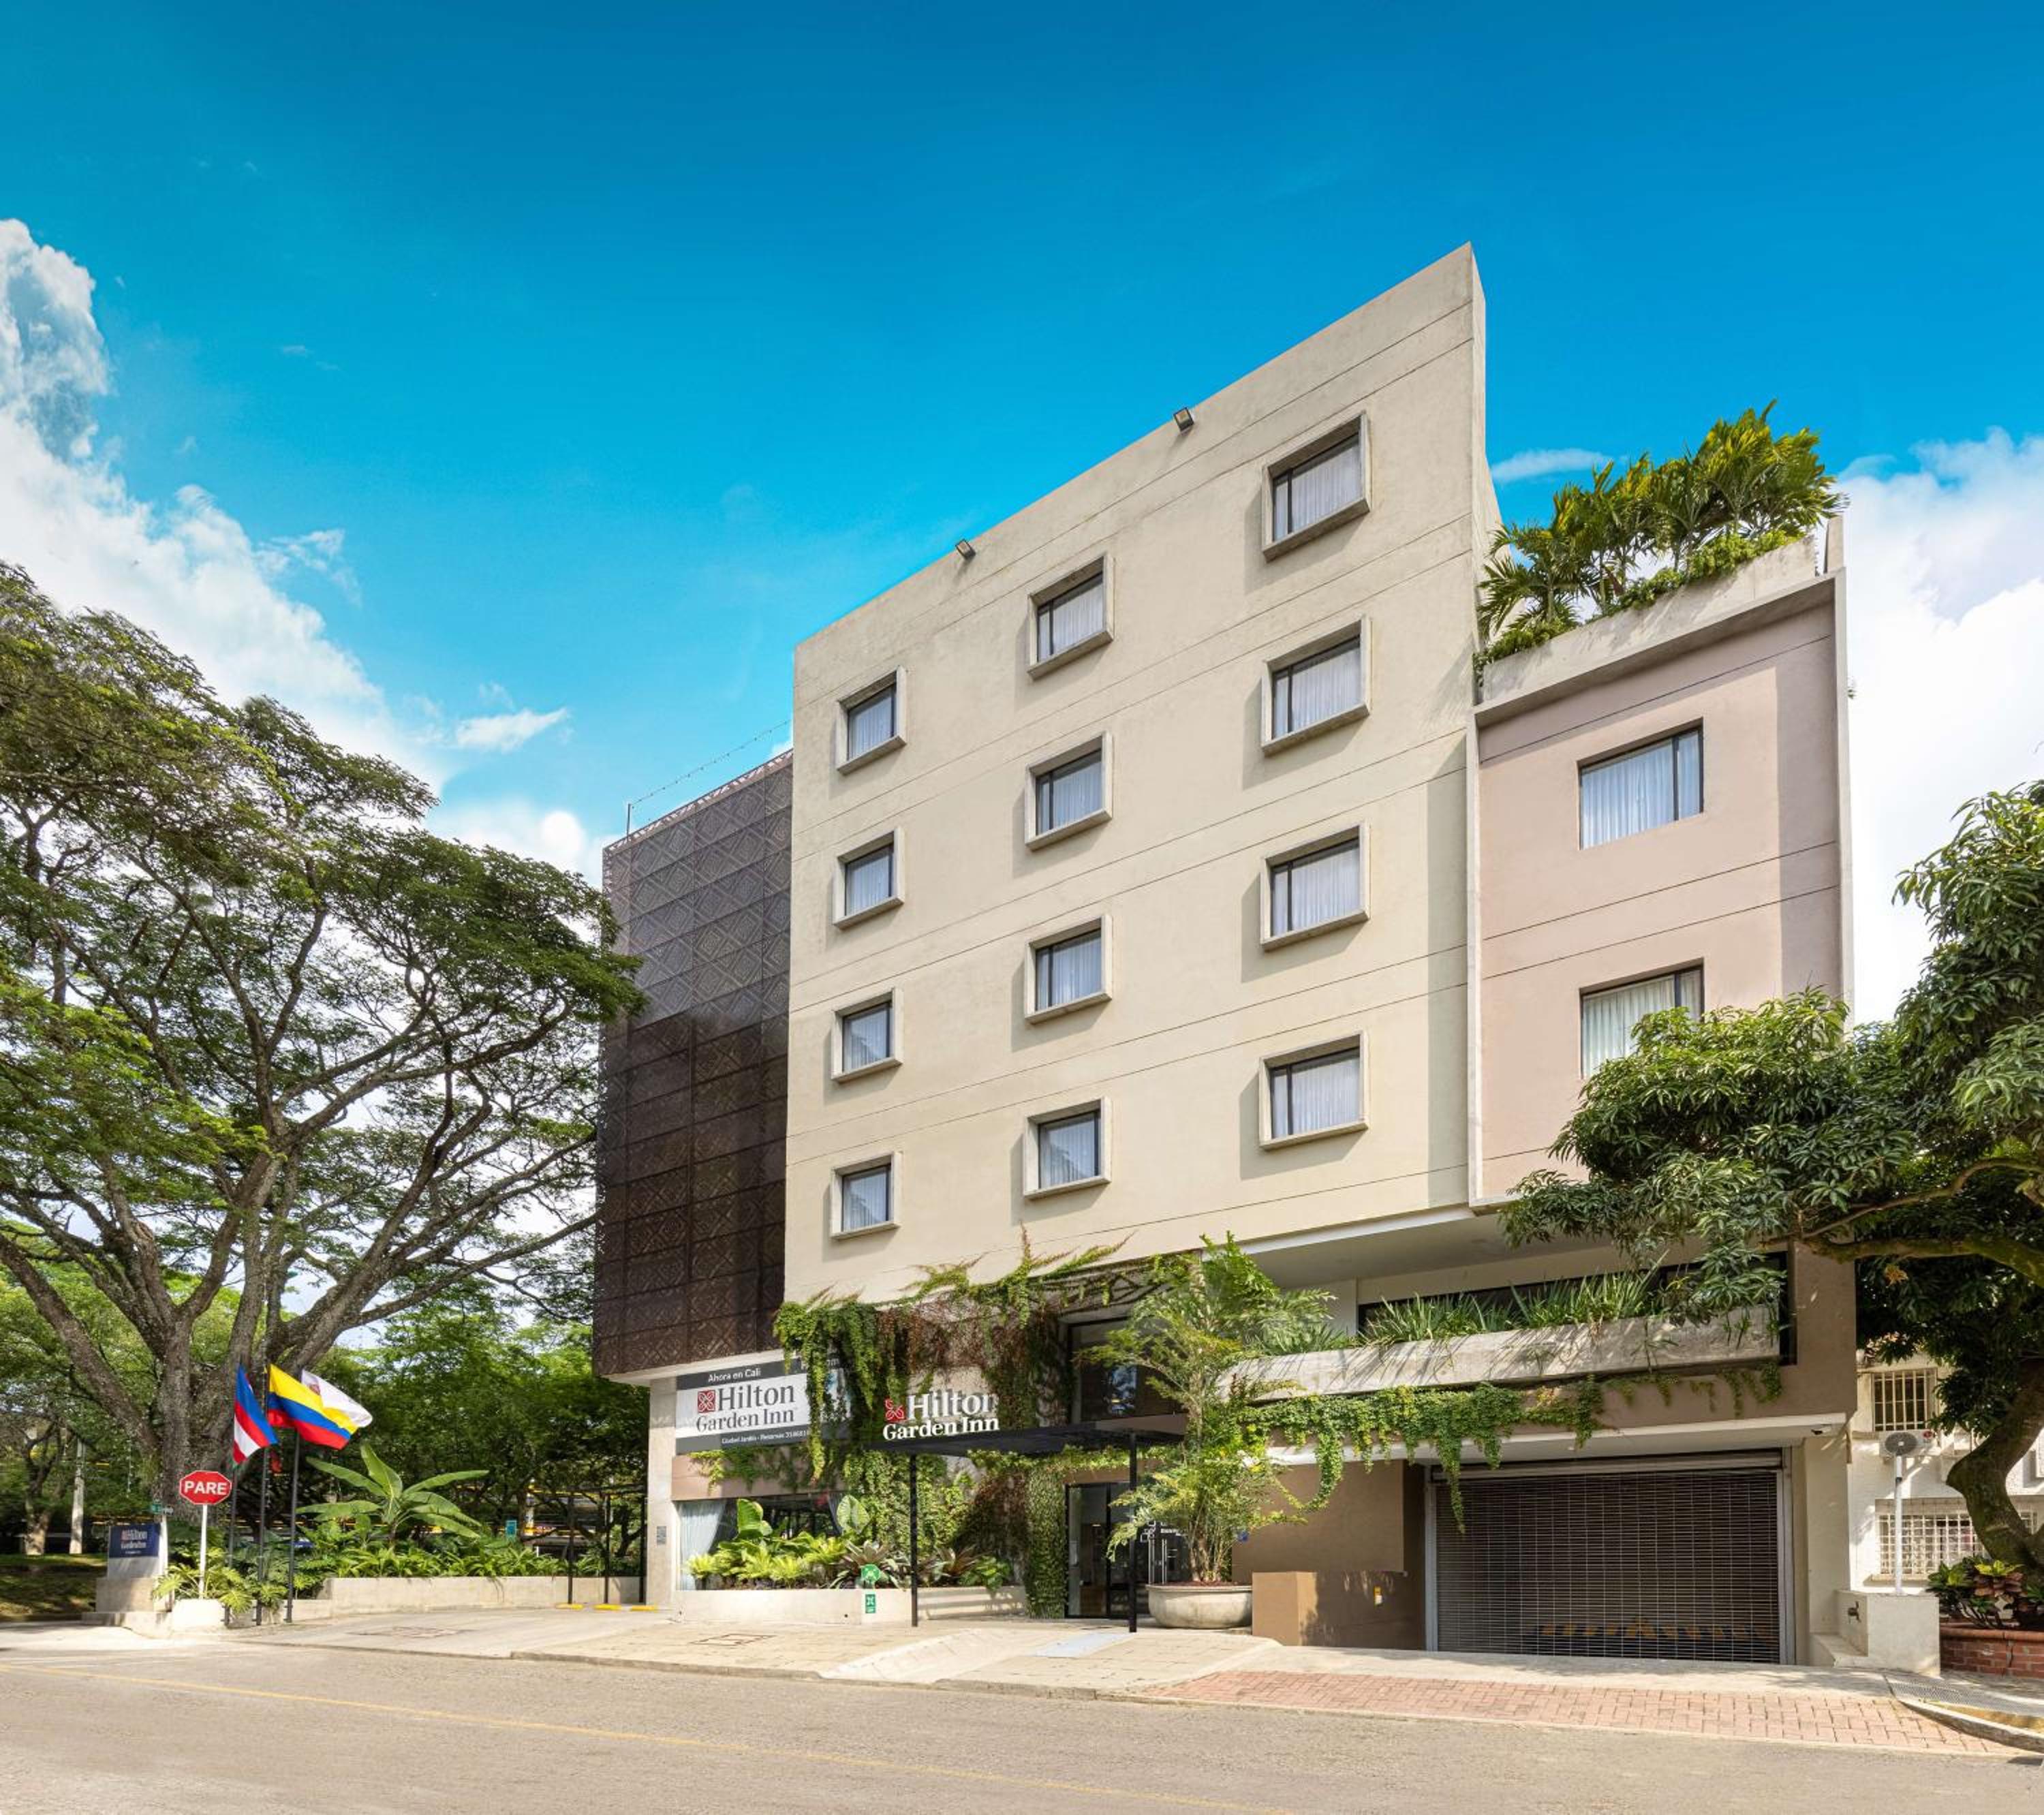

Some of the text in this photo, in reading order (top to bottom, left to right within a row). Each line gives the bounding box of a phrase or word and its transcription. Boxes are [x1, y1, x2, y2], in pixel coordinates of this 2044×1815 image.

[708, 1367, 761, 1382] Ahora en Cali
[717, 1384, 795, 1411] Hilton
[696, 1408, 794, 1432] Garden Inn
[882, 1416, 1000, 1441] Garden Inn
[184, 1480, 227, 1495] PARE
